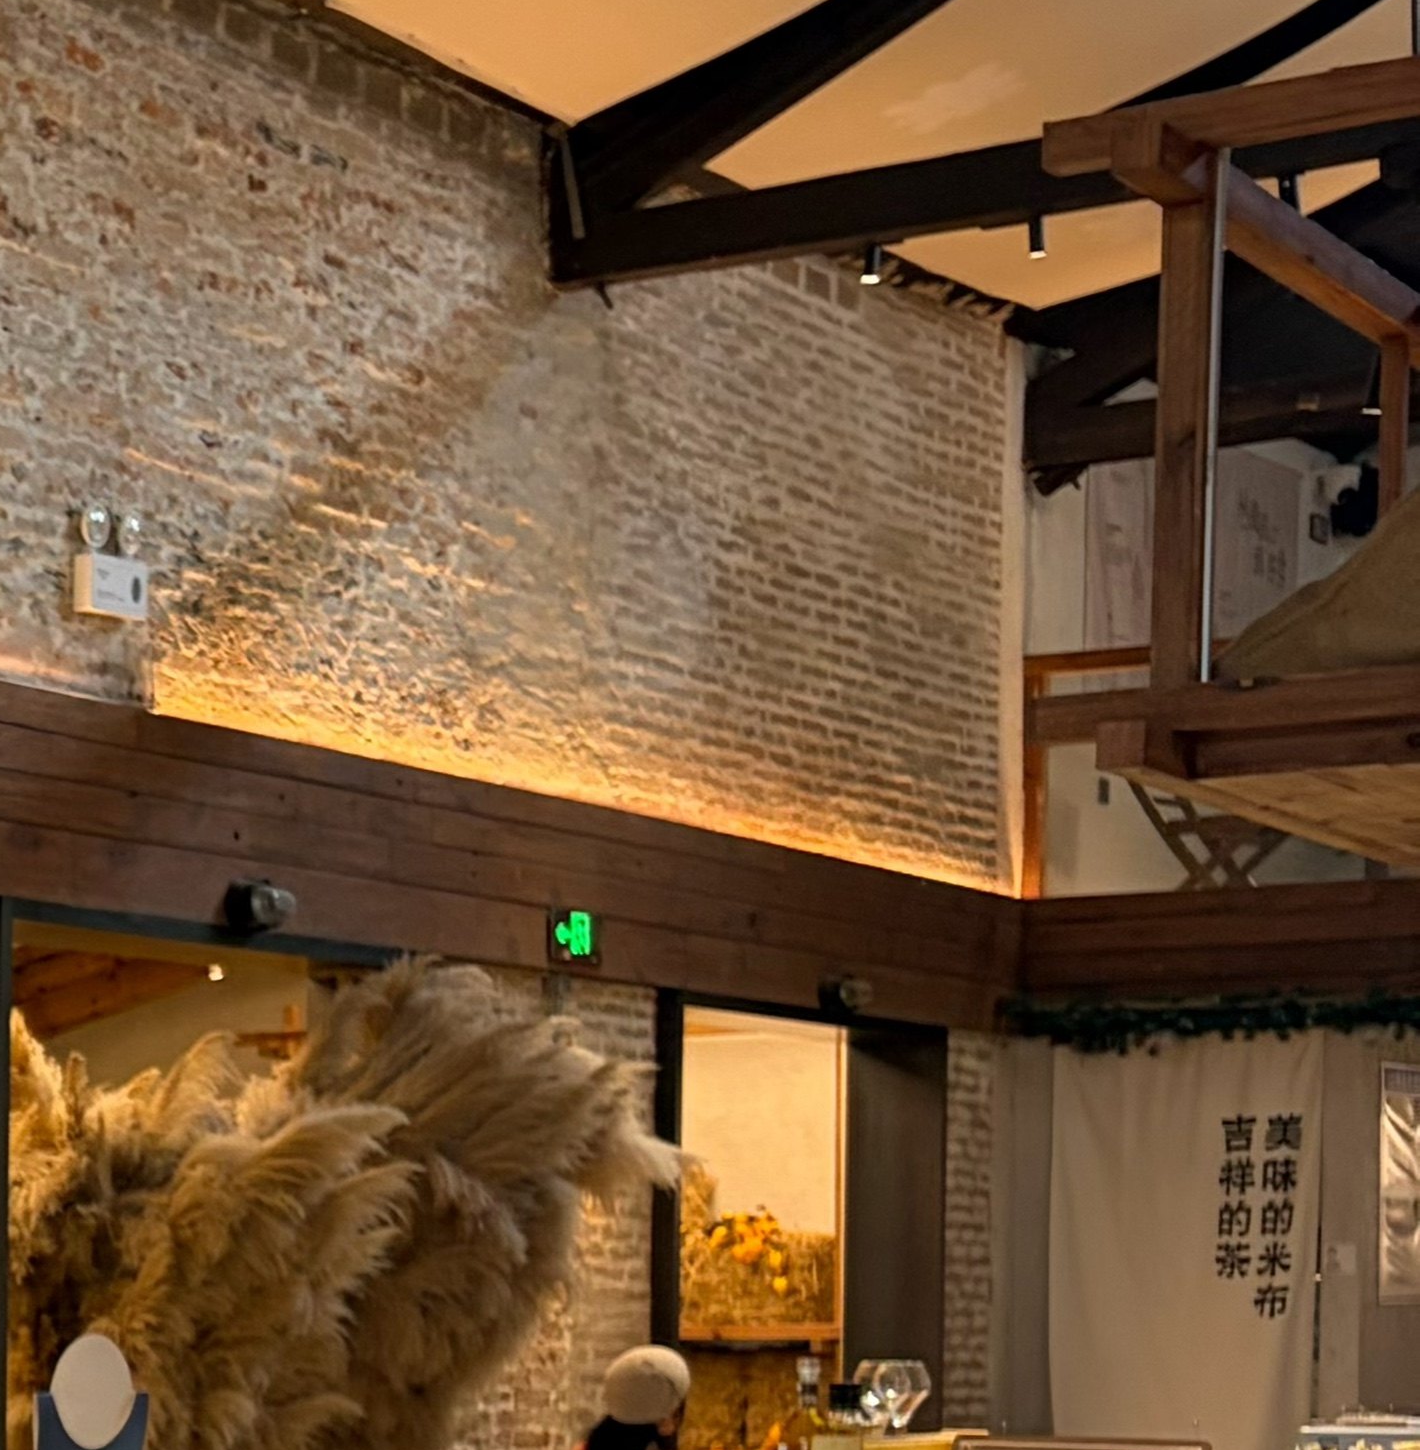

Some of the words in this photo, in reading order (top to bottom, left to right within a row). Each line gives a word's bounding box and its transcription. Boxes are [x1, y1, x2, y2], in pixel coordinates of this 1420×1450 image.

[1215, 1112, 1257, 1279] 吉祥的茶
[1254, 1112, 1303, 1319] 美味的米布
